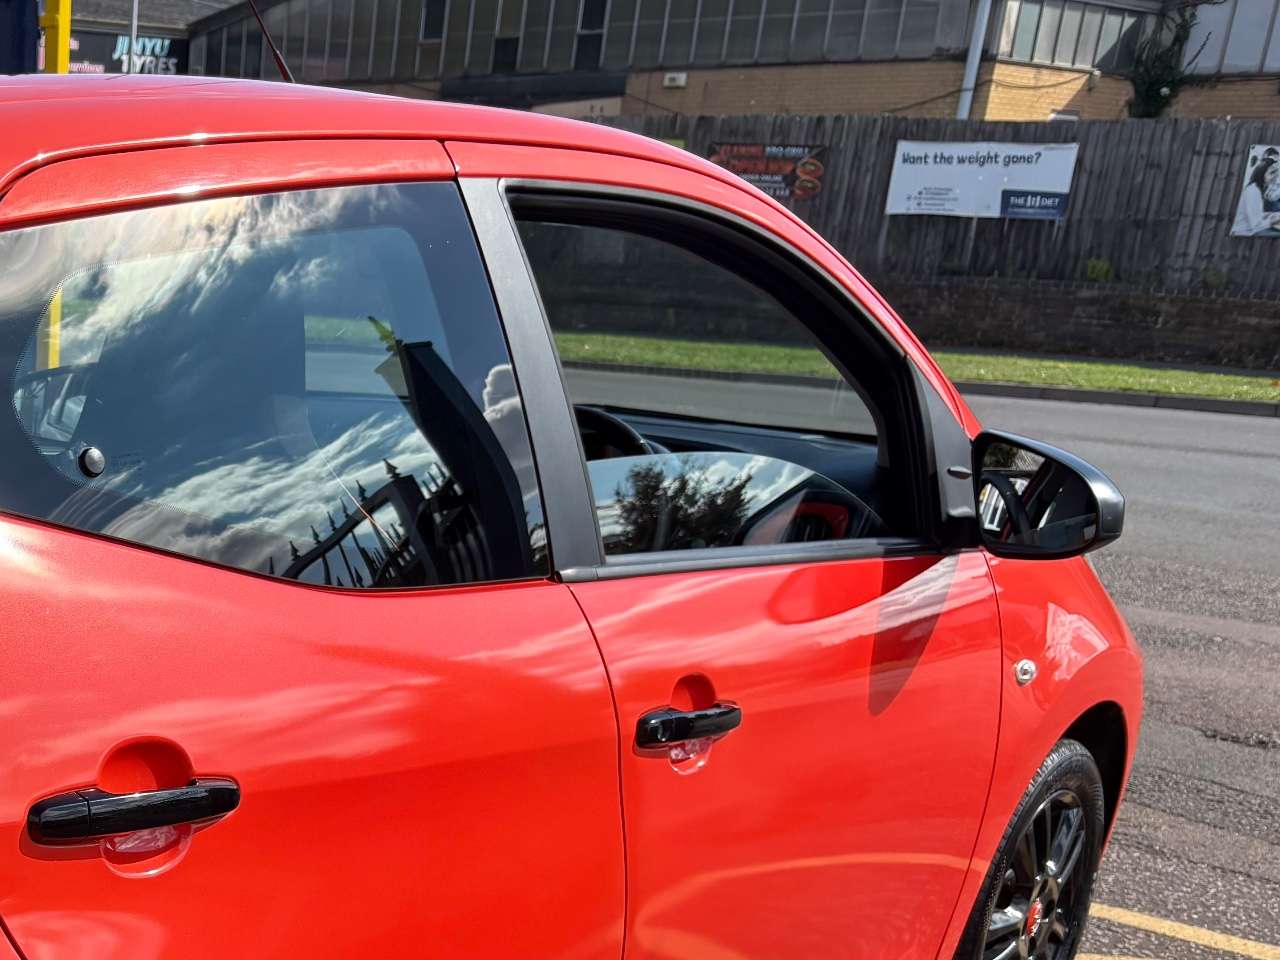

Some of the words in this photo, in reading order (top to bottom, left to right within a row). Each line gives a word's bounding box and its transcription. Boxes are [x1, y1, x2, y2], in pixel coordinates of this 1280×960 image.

[112, 35, 171, 61] JINYU
[902, 151, 929, 166] Want
[933, 152, 953, 166] the
[956, 151, 999, 168] weight
[1003, 151, 1042, 167] gone?
[1009, 196, 1025, 206] THE
[1041, 196, 1060, 207] DIET
